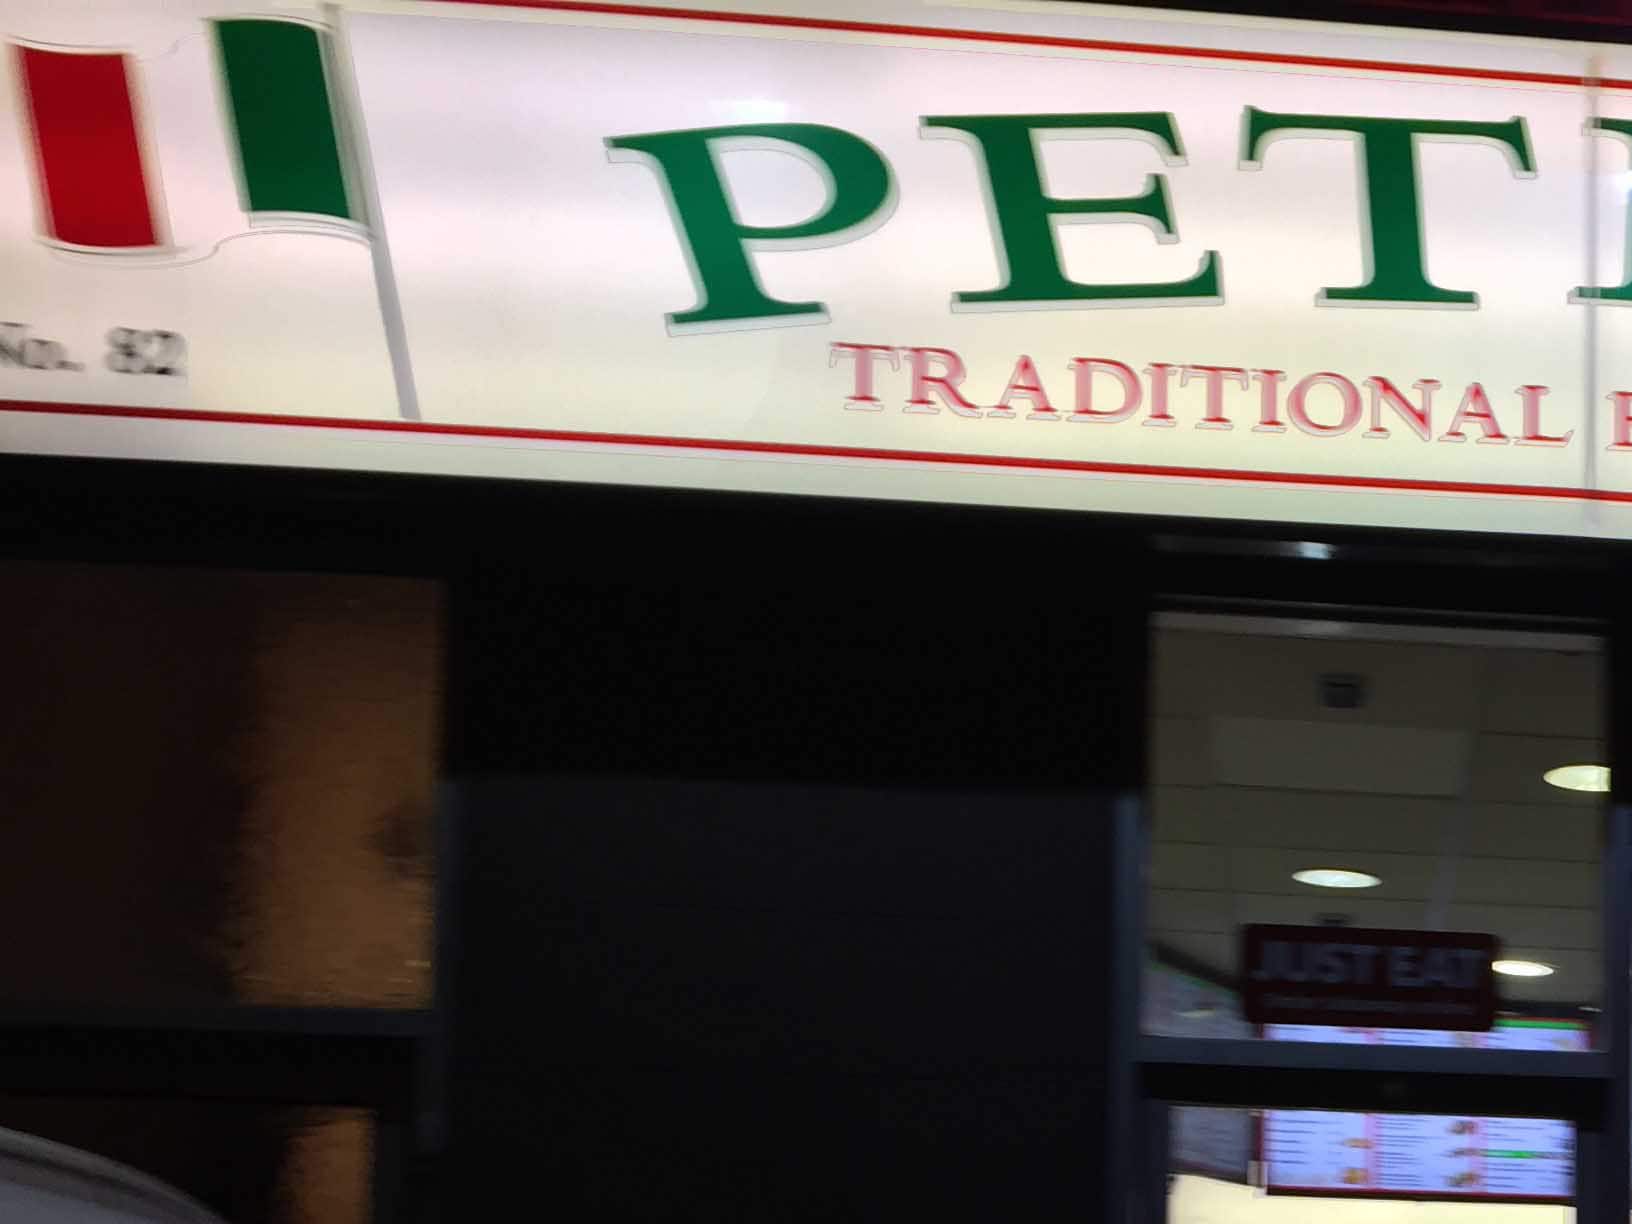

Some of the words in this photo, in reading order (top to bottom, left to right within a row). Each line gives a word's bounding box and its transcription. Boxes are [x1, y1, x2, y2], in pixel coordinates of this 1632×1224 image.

[105, 326, 188, 375] 82
[828, 341, 1575, 447] TRADITIONAL
[1250, 940, 1378, 985] JUST
[1388, 945, 1489, 990] EAT
